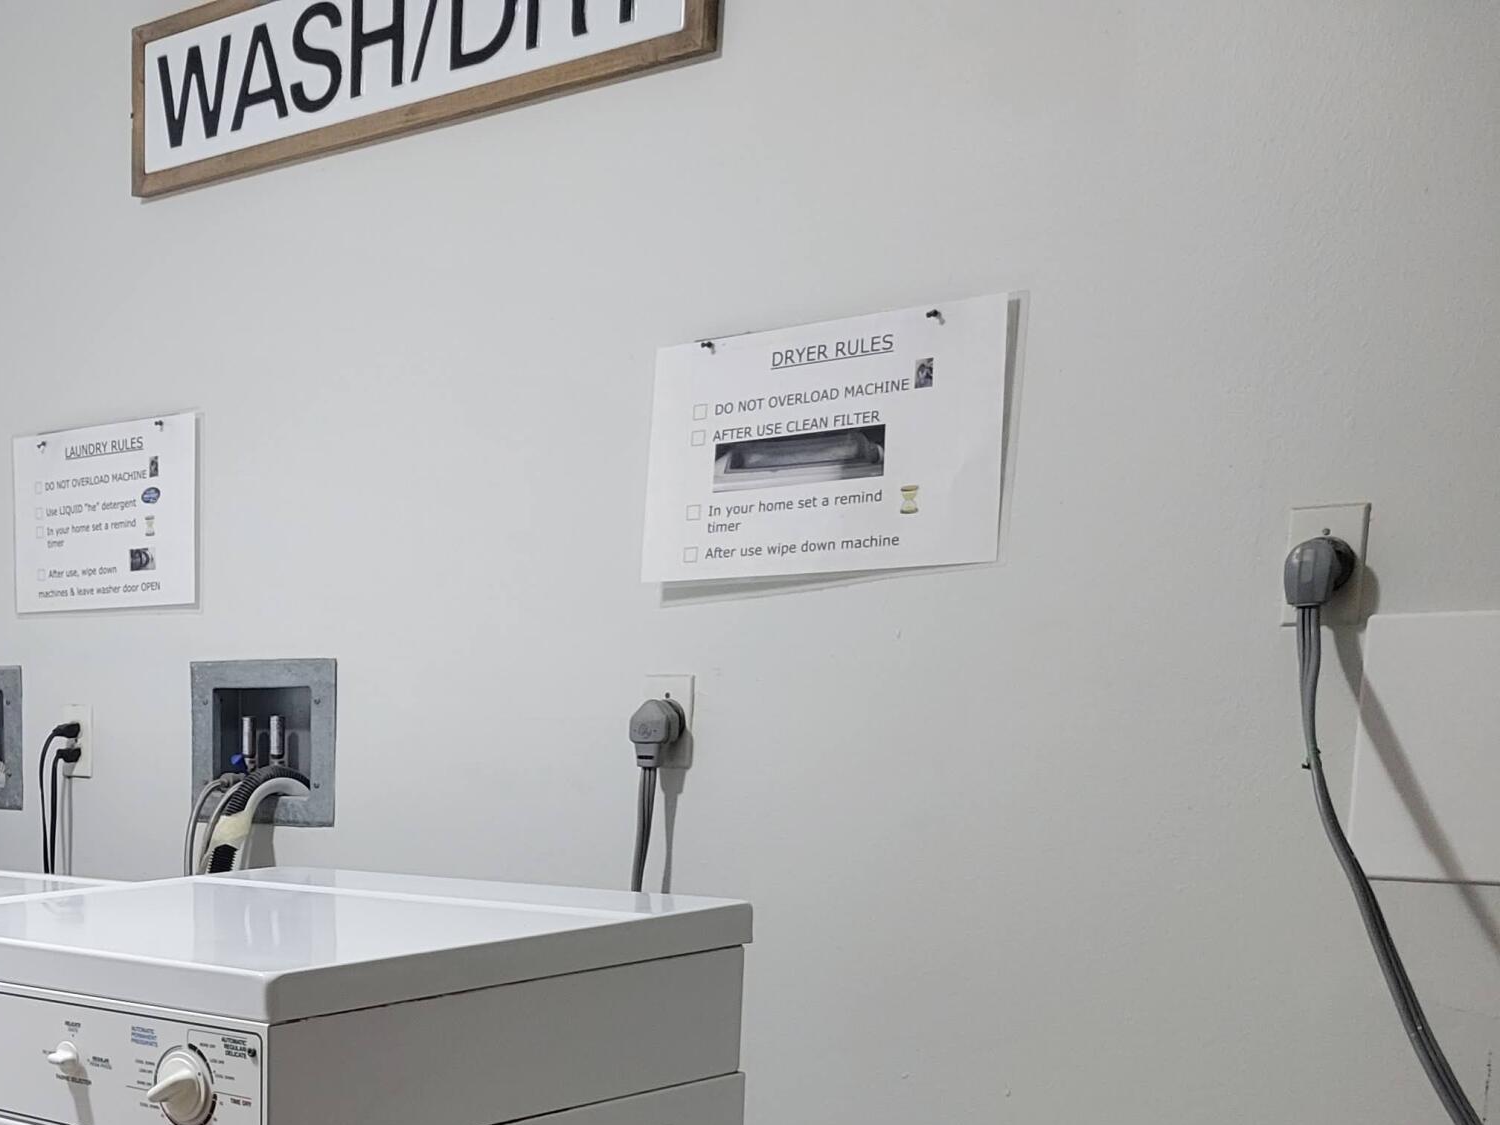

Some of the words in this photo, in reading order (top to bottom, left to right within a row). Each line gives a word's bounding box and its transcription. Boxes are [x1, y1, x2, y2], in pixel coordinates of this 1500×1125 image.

[158, 0, 634, 149] WASH/D
[771, 345, 829, 367] DRYER
[835, 334, 894, 357] RULES
[715, 402, 734, 416] DO
[738, 398, 764, 412] NOT
[768, 388, 839, 409] OVERLOAD
[844, 379, 910, 399] MACHINE
[712, 426, 752, 442] AFTER
[757, 423, 783, 436] USE
[786, 417, 828, 432] CLEAN
[833, 411, 880, 428] FILTER
[65, 441, 107, 458] LAUNDRY
[111, 437, 143, 452] RULES
[45, 482, 55, 491] DO
[57, 480, 70, 489] NOT
[72, 475, 109, 487] OVERLOAD
[112, 470, 147, 482] MACHINE
[46, 507, 58, 517] Use
[60, 504, 82, 516] LIQUID
[84, 503, 99, 512] "he"
[102, 499, 137, 511] detergent
[709, 505, 719, 517] In
[726, 503, 755, 519] your
[759, 499, 793, 512] home
[798, 495, 818, 509] set
[822, 495, 829, 507] a
[834, 490, 882, 505] remind
[47, 528, 53, 536] In
[56, 527, 70, 537] your
[71, 524, 90, 533] home
[92, 523, 102, 531] set
[111, 519, 136, 528] remind
[708, 519, 741, 534] timer
[47, 539, 64, 547] timer
[705, 546, 737, 560] After
[740, 545, 762, 557] use
[767, 542, 796, 558] wipe
[801, 539, 836, 552] down
[841, 535, 899, 550] machine
[49, 570, 64, 578] After
[66, 569, 79, 577] use,
[82, 568, 97, 577] wipe
[99, 566, 117, 574] down
[39, 589, 68, 598] machines
[70, 588, 75, 596] &
[77, 587, 94, 595] leave
[96, 584, 120, 594] washer
[123, 583, 139, 592] door
[141, 582, 160, 591] OPEN
